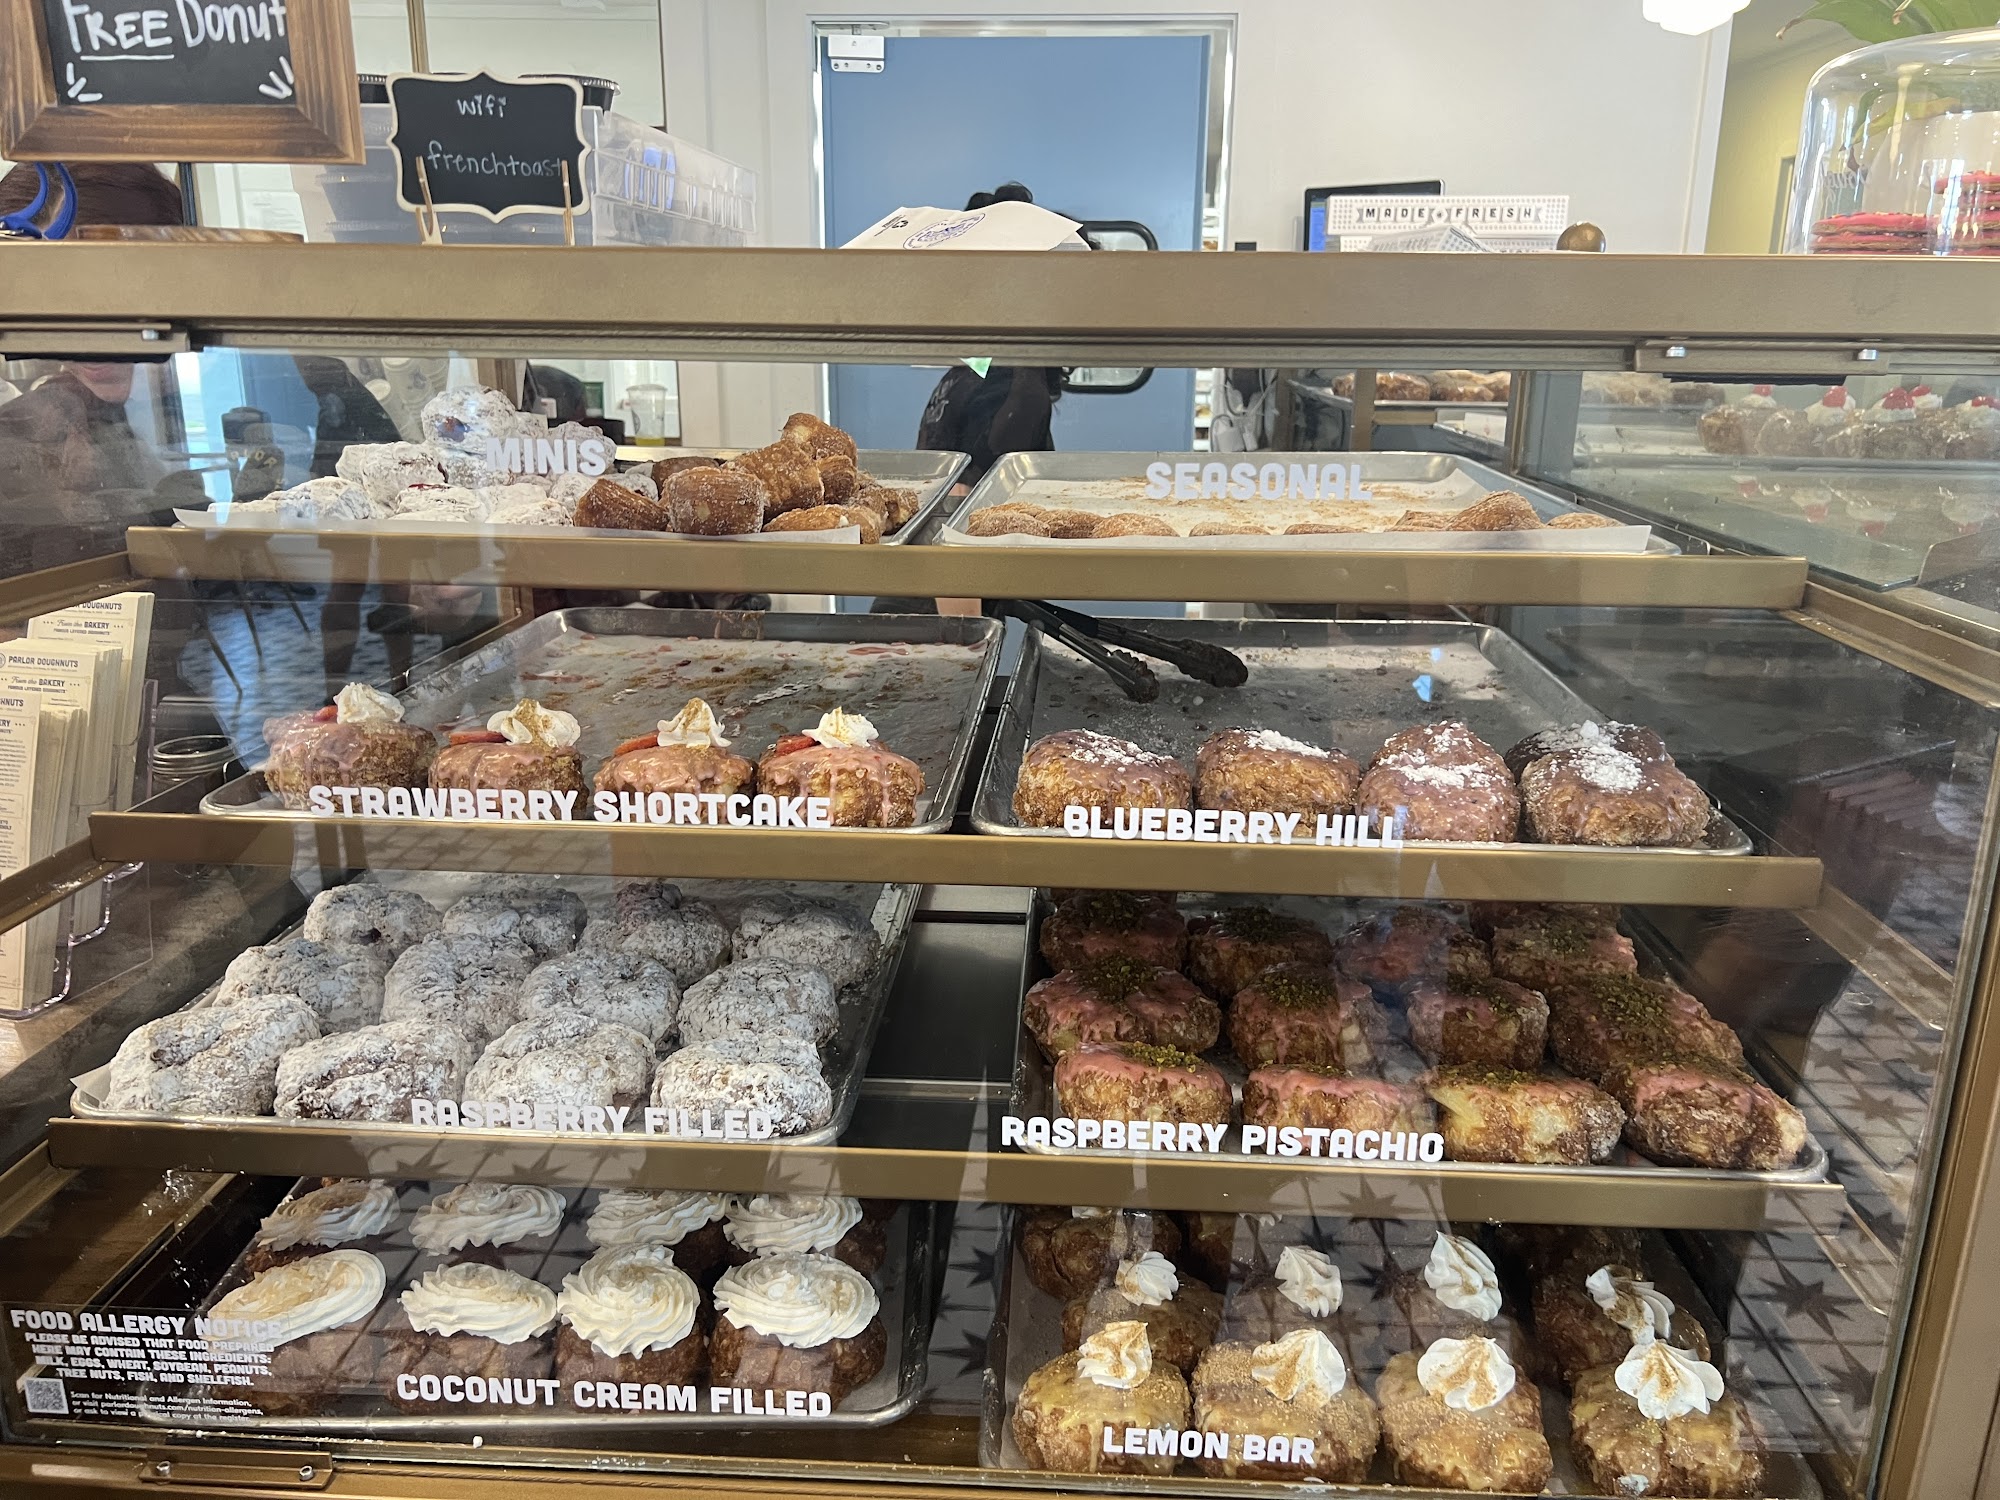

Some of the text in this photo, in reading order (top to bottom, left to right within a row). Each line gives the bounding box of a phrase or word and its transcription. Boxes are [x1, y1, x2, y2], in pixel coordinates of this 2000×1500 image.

[62, 0, 287, 53] FREE Donut
[457, 94, 507, 118] wifi
[427, 140, 562, 177] frenchtoast
[1365, 208, 1532, 218] MADE FRESH
[486, 437, 606, 477] MINIS
[1144, 462, 1372, 500] SEASONAL
[84, 621, 110, 629] BAKERY
[8, 655, 79, 668] PARLOR DOUGHNUTS
[38, 678, 66, 687] BAKERY
[309, 785, 832, 829] STRAWBERRY SHORTCAKE
[1063, 804, 1404, 849] BLUEBERRY HILL
[411, 1098, 773, 1140] RASPBERRY FILLED
[1001, 1115, 1446, 1163] RASPBERRY PISTACHIO
[10, 1309, 283, 1339] FOOD ALLERGY NOTICE
[24, 1332, 275, 1353] PLEASE BE ADVISED THAT FOOD PREPARED
[31, 1343, 272, 1364] HERE MAY CONTAIN THESE INGREDIENTS:
[56, 1367, 255, 1386] TREE NUTS, FISH, AND SHELLFISH.
[70, 1357, 105, 1369] EGGS,
[106, 1358, 151, 1371] WHEAT,
[213, 1363, 273, 1377] PEANUTS,
[70, 1391, 90, 1399] Scan
[91, 1392, 104, 1400] for
[104, 1393, 148, 1402] Nutritional
[149, 1395, 165, 1403] and
[167, 1395, 202, 1405] Allergen
[397, 1373, 832, 1418] COCONUT CREAM FILLED
[172, 1412, 192, 1421] copy
[193, 1412, 203, 1420] at
[203, 1413, 218, 1421] the
[1102, 1425, 1316, 1465] LEMON BAR
